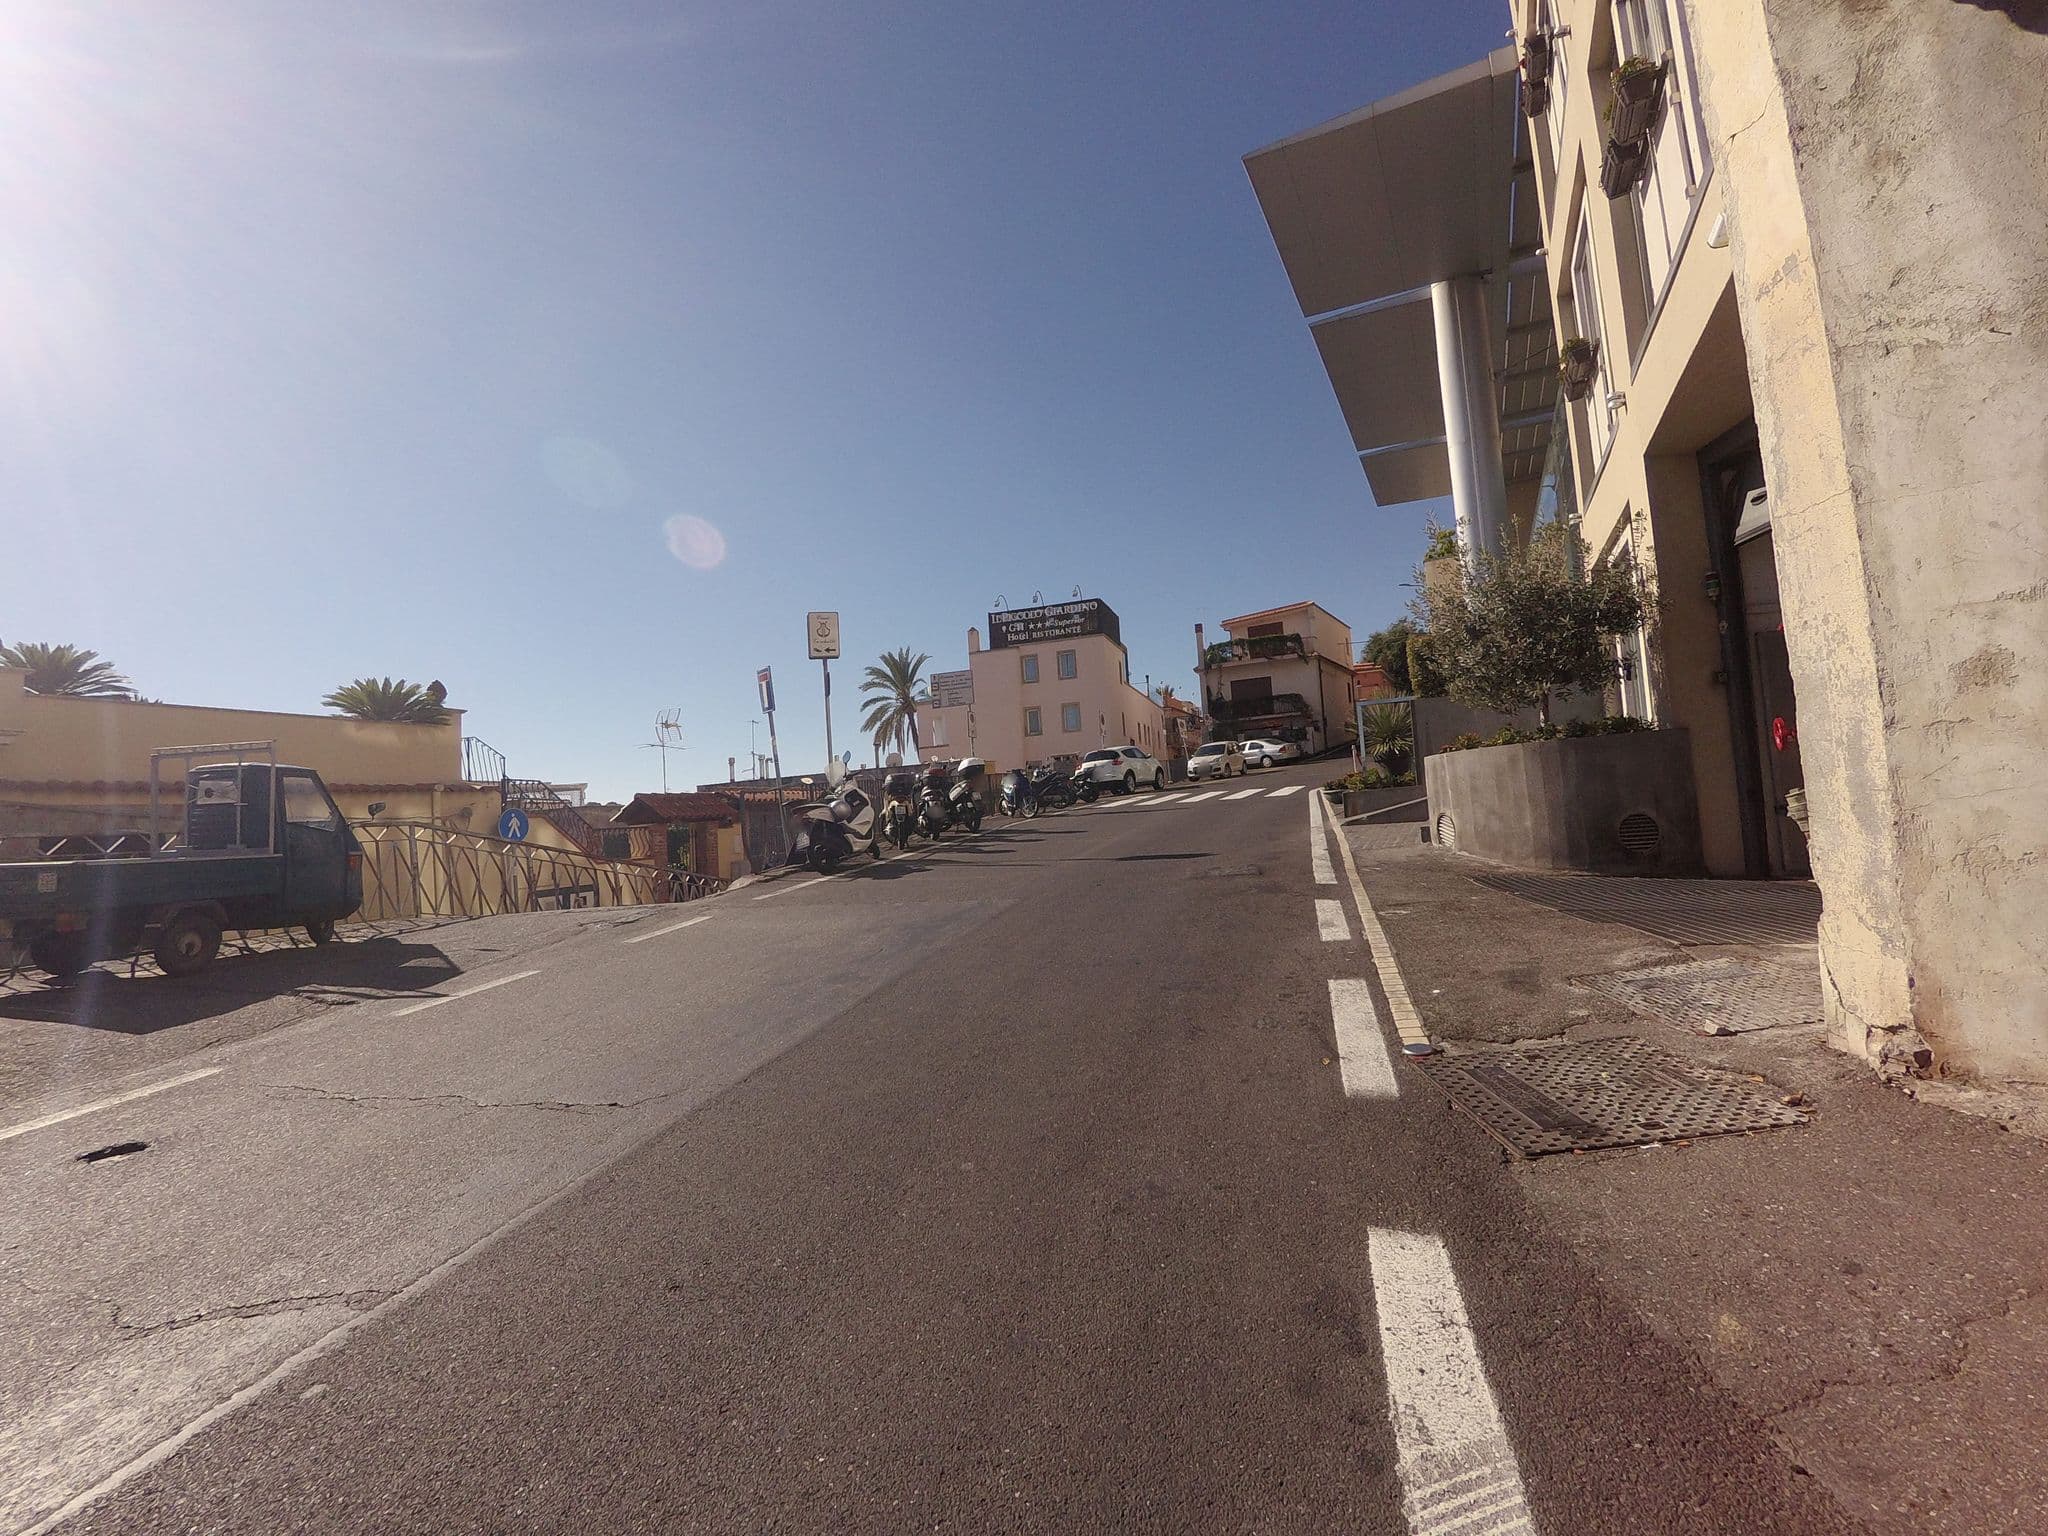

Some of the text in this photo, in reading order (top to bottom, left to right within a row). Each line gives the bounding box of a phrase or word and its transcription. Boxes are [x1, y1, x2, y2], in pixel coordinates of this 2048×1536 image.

[1002, 610, 1042, 622] PICCOLO
[1044, 601, 1098, 616] GIARDINO
[1007, 626, 1082, 641] Hotel RISTORANTE
